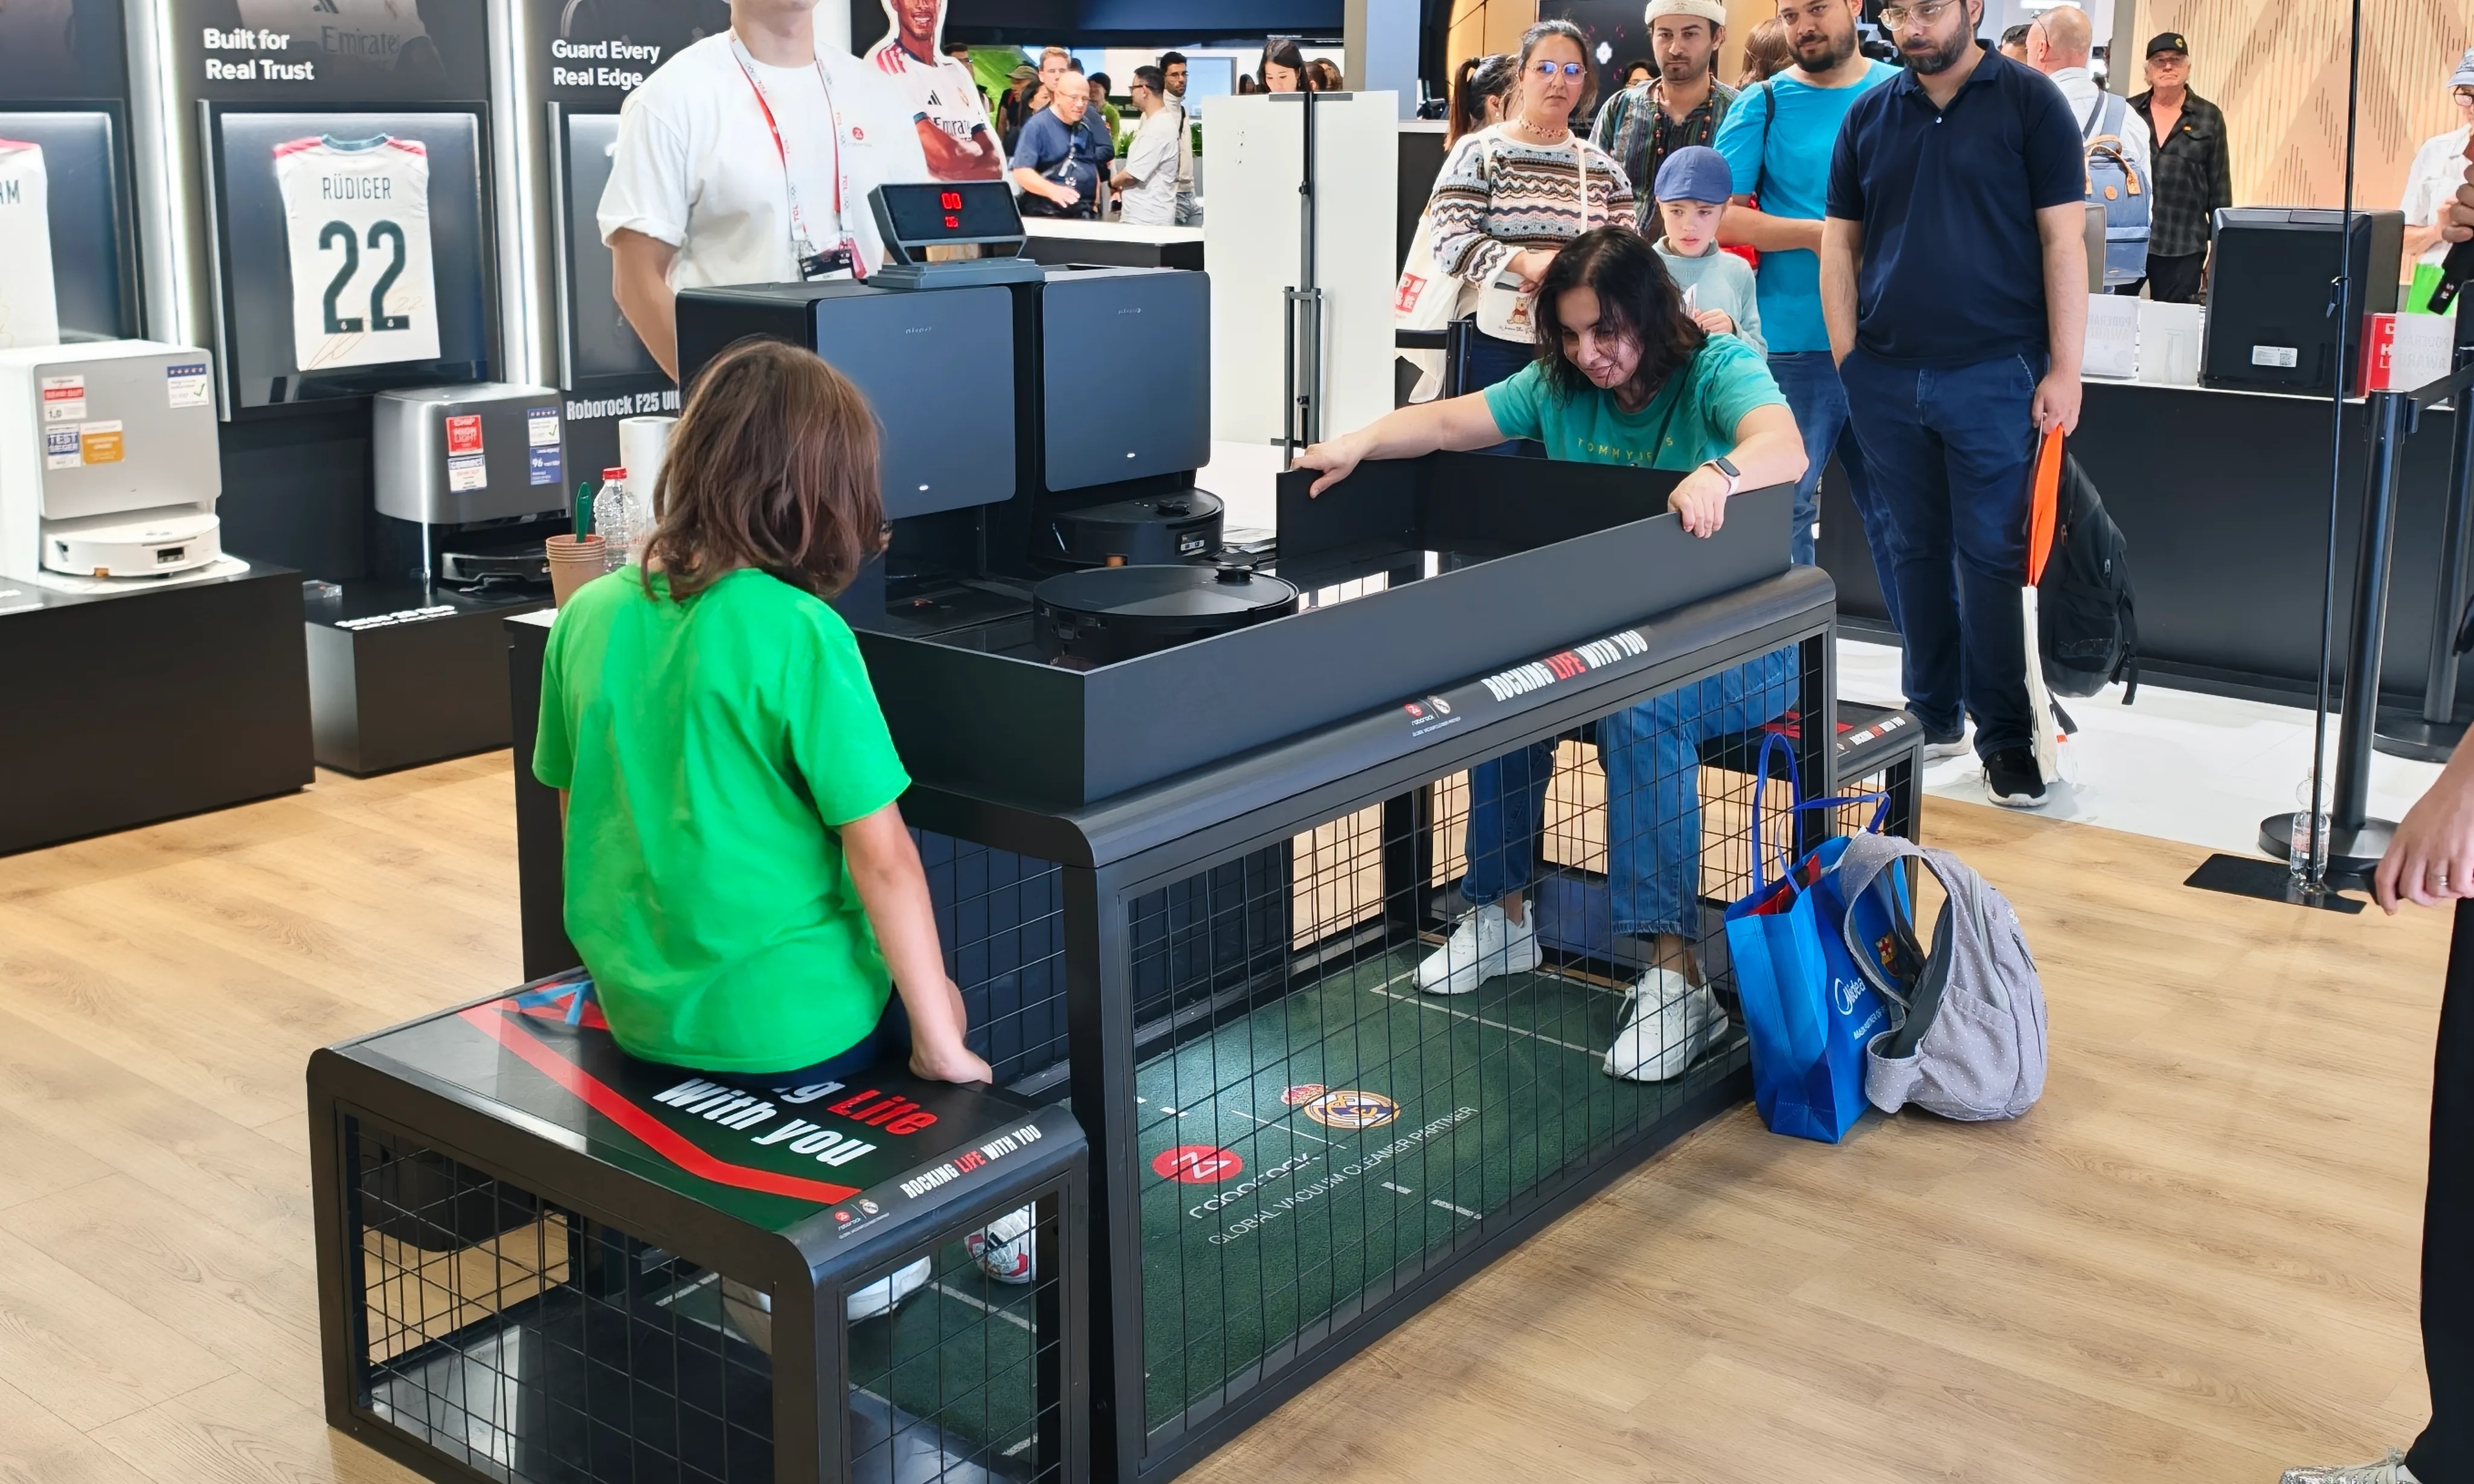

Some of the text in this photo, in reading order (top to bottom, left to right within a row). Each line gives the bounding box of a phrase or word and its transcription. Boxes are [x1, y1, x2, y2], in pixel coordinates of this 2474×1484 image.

[203, 28, 291, 50] Built for
[551, 39, 661, 64] Guard Every
[205, 59, 315, 80] Real Trust
[553, 67, 643, 91] Real Edge
[322, 173, 392, 200] RÜDIGER
[318, 219, 410, 335] 22
[567, 396, 634, 420] Roborock
[636, 392, 660, 413] F25
[1578, 437, 1633, 460] TOMMY
[1480, 629, 1648, 702] ROCKING LIFE WITH YOU
[1834, 977, 1866, 1015] Midea
[652, 1078, 777, 1130] With
[750, 1118, 878, 1167] you
[826, 1088, 938, 1135] Life
[899, 1123, 1043, 1199] ROCKING LIFE WITH YOU
[1208, 1106, 1479, 1245] GLOBAL VACUUM CLEANER PARTNER
